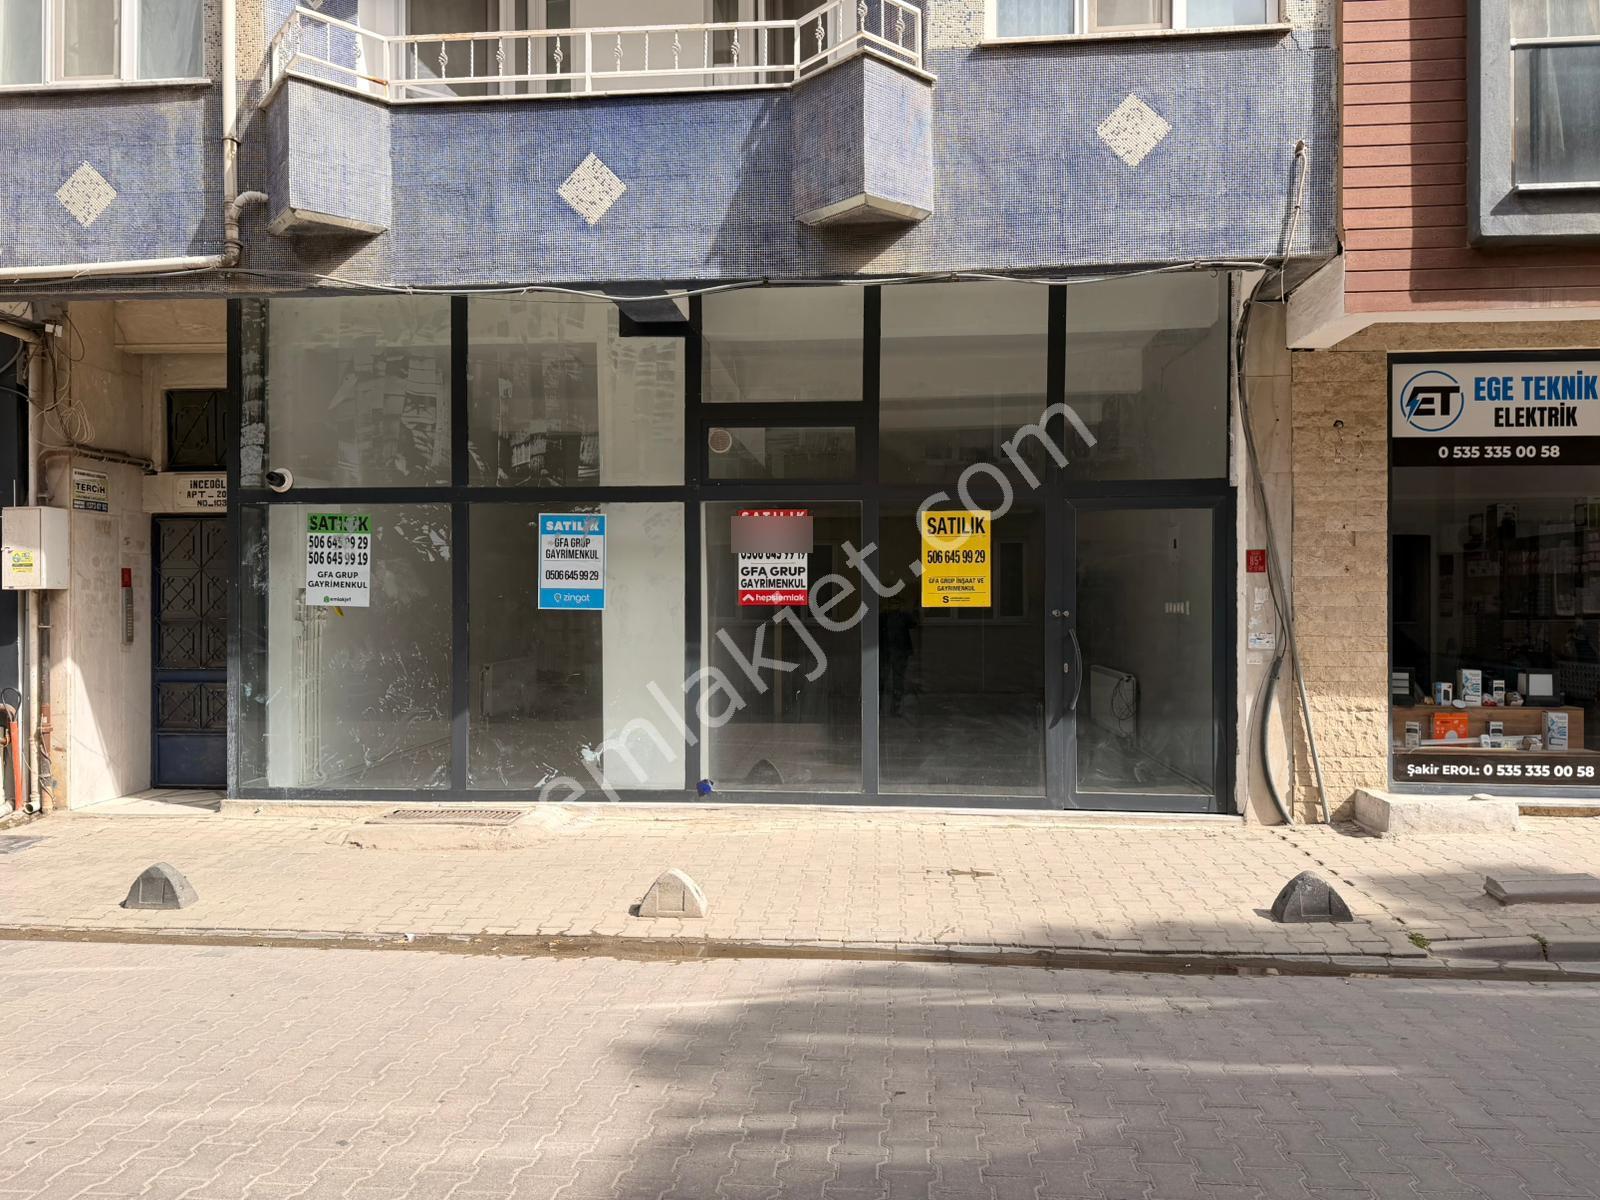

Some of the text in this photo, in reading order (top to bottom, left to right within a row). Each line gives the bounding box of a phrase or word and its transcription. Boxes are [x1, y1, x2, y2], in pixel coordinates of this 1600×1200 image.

[1474, 370, 1599, 401] EGE TEKNİK
[1406, 386, 1460, 416] ET
[1494, 402, 1578, 428] ELEKTRİK
[1438, 445, 1560, 459] 0 535 335 00 58
[928, 516, 986, 535] SATILIK
[308, 535, 325, 548] 506
[357, 536, 369, 549] 29
[554, 537, 591, 548] GFA GRUP
[308, 551, 325, 565] 506
[327, 551, 342, 565] 645
[357, 552, 369, 566] 19
[545, 548, 599, 560] GAYRİMENKUL
[928, 550, 986, 563] 506 645 99 29
[317, 570, 359, 579] GFA GRUP
[545, 570, 599, 581] 0506 645 99 29
[740, 566, 806, 577] GFA GRUP
[308, 578, 368, 589] GAYRİMENKUL
[740, 578, 806, 589] GAYRİMENKUL
[563, 593, 590, 604] zingat
[1407, 763, 1595, 778] Şakir EROL: 0 535 335 00 58
